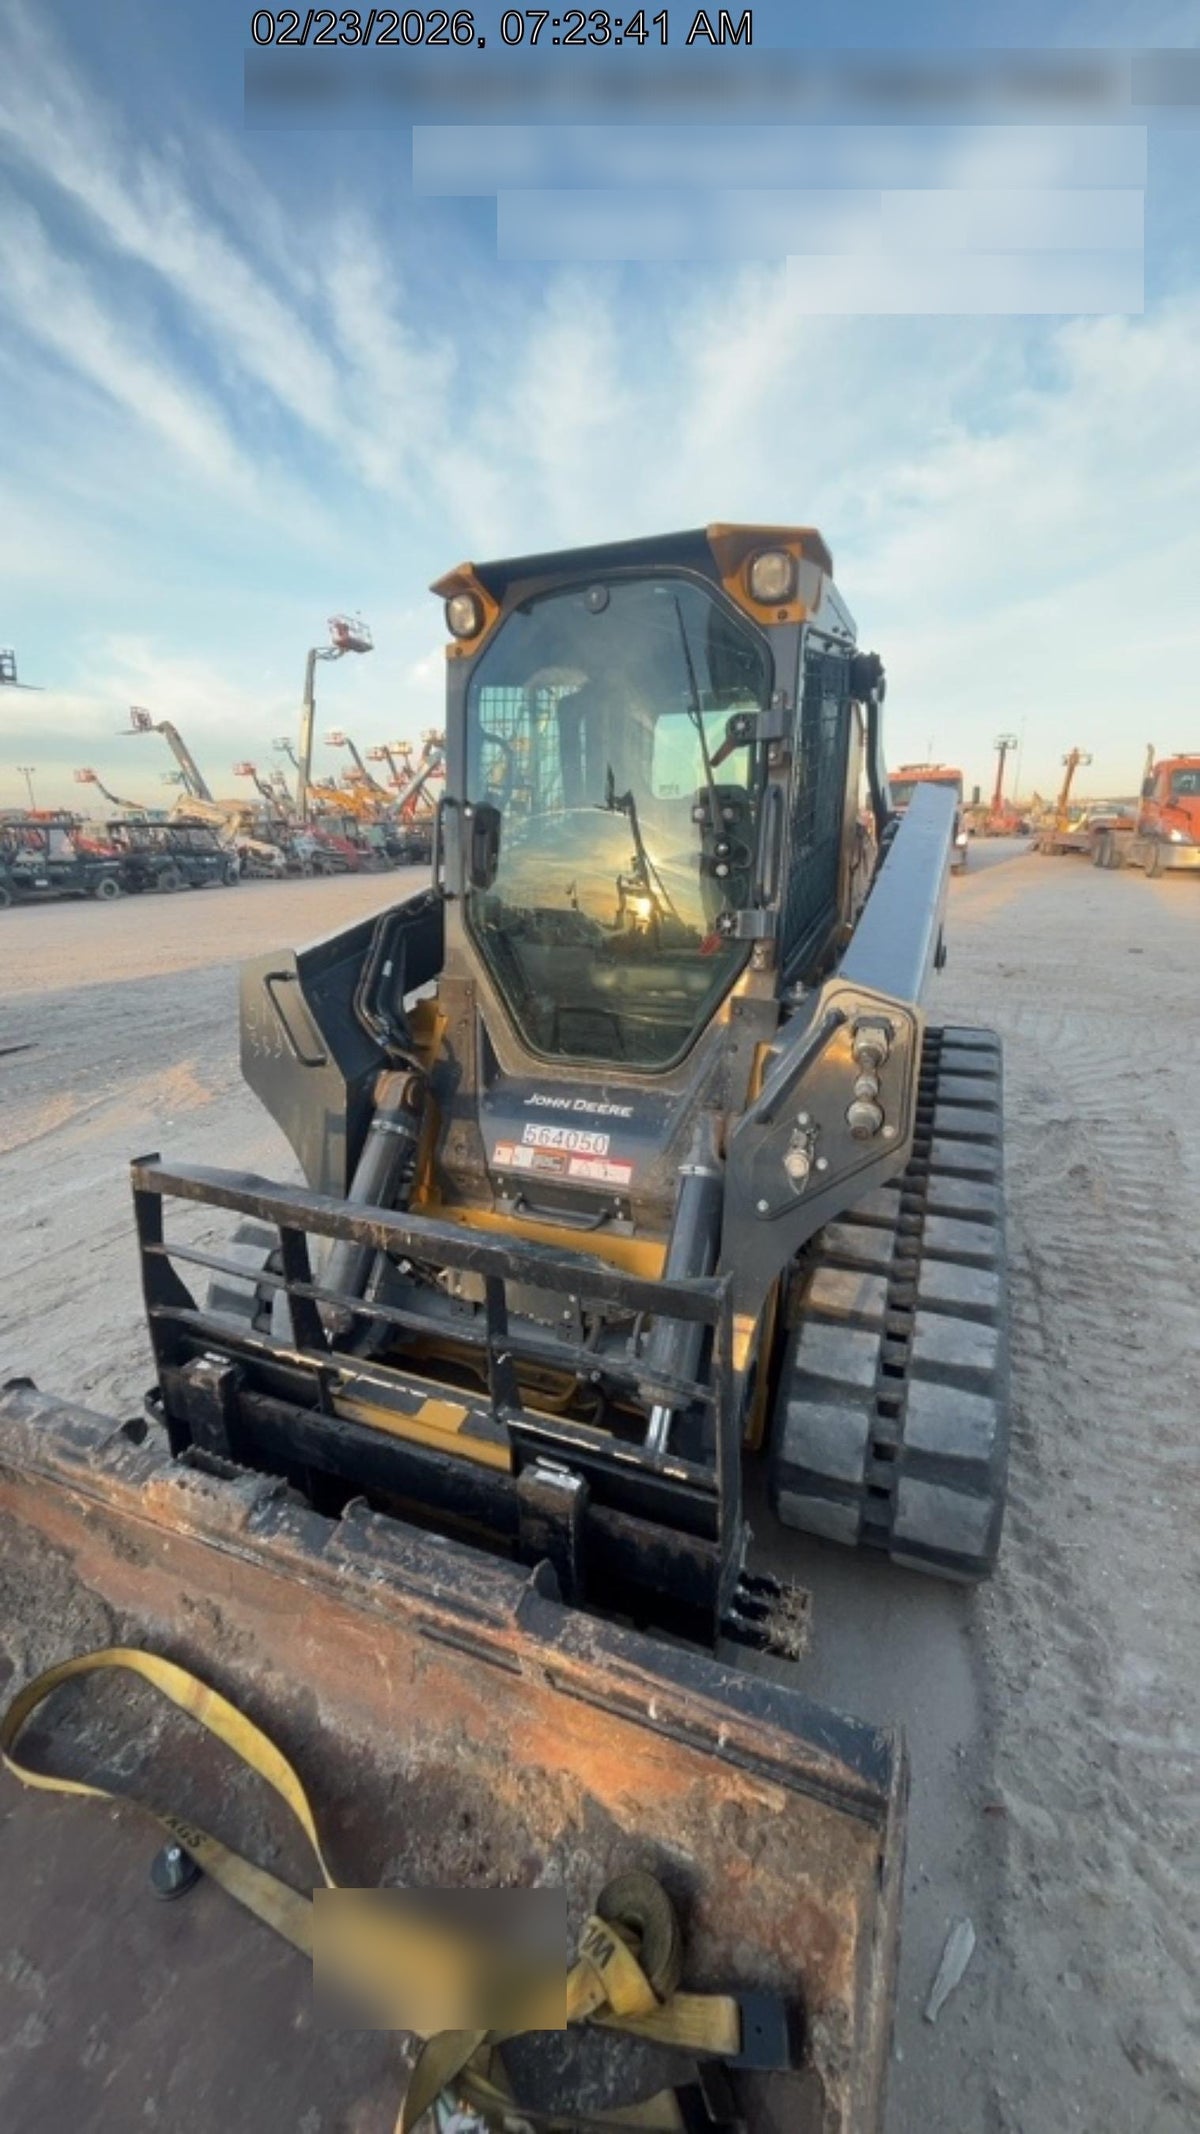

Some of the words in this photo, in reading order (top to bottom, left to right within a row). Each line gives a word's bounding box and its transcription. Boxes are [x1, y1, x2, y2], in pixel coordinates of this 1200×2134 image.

[523, 1093, 570, 1110] JOHN
[573, 1099, 634, 1118] DEERE
[524, 1126, 606, 1154] 564050
